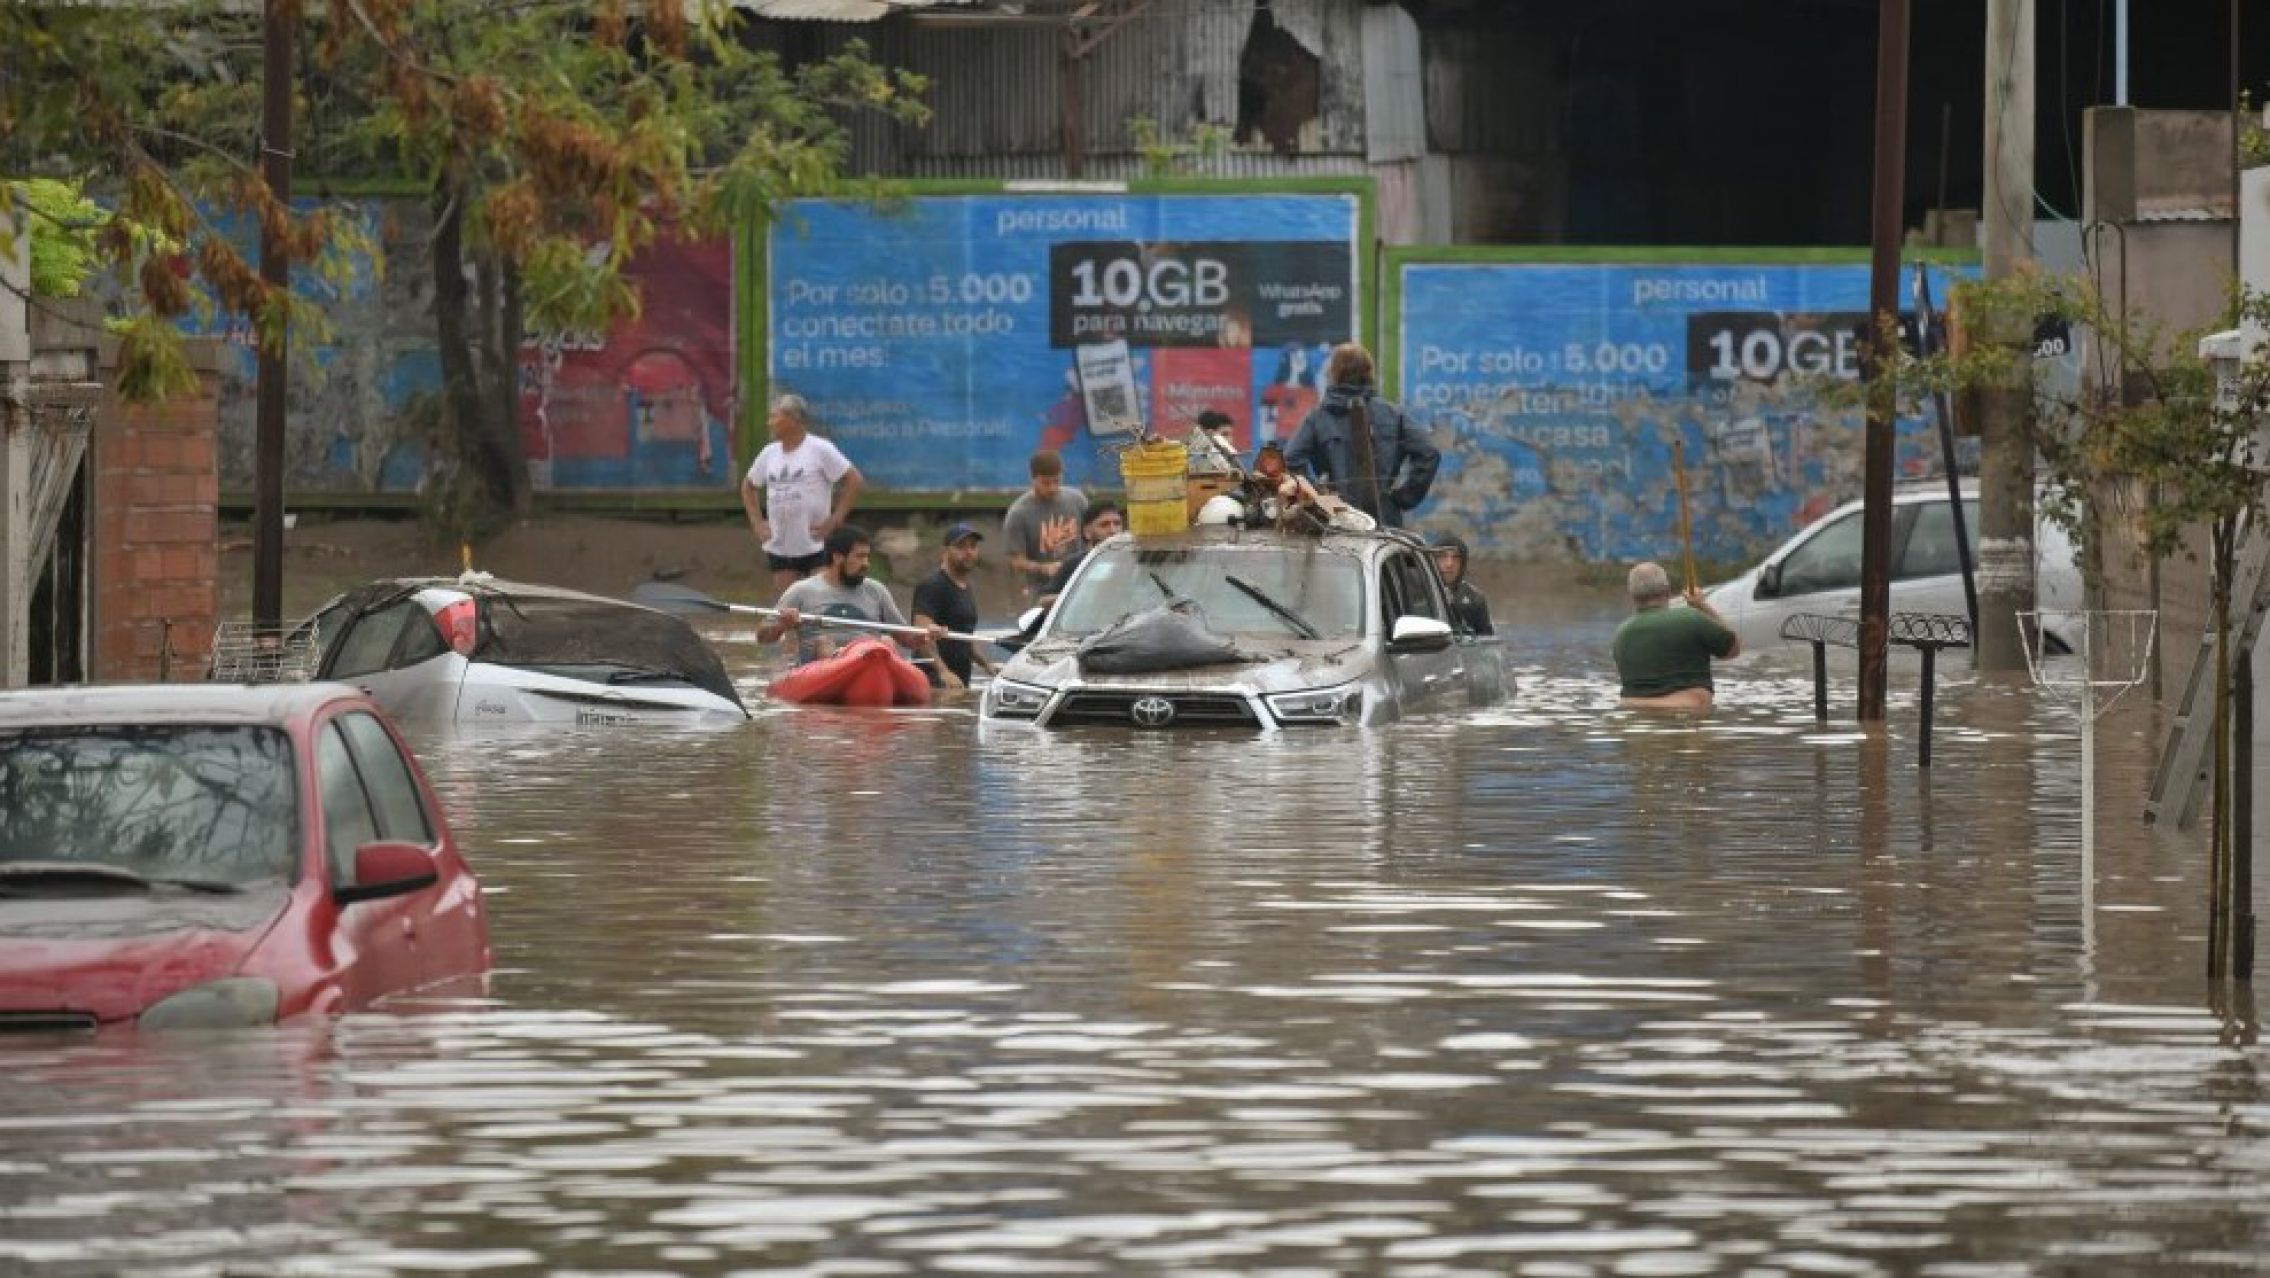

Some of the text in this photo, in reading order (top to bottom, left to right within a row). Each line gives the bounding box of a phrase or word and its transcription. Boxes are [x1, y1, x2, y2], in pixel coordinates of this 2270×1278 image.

[998, 204, 1127, 236] personal
[847, 277, 908, 305] solo
[1633, 273, 1767, 305] personal
[944, 308, 1014, 335] todo
[1073, 313, 1127, 336] para
[783, 341, 809, 368] el
[1477, 345, 1543, 374] solo
